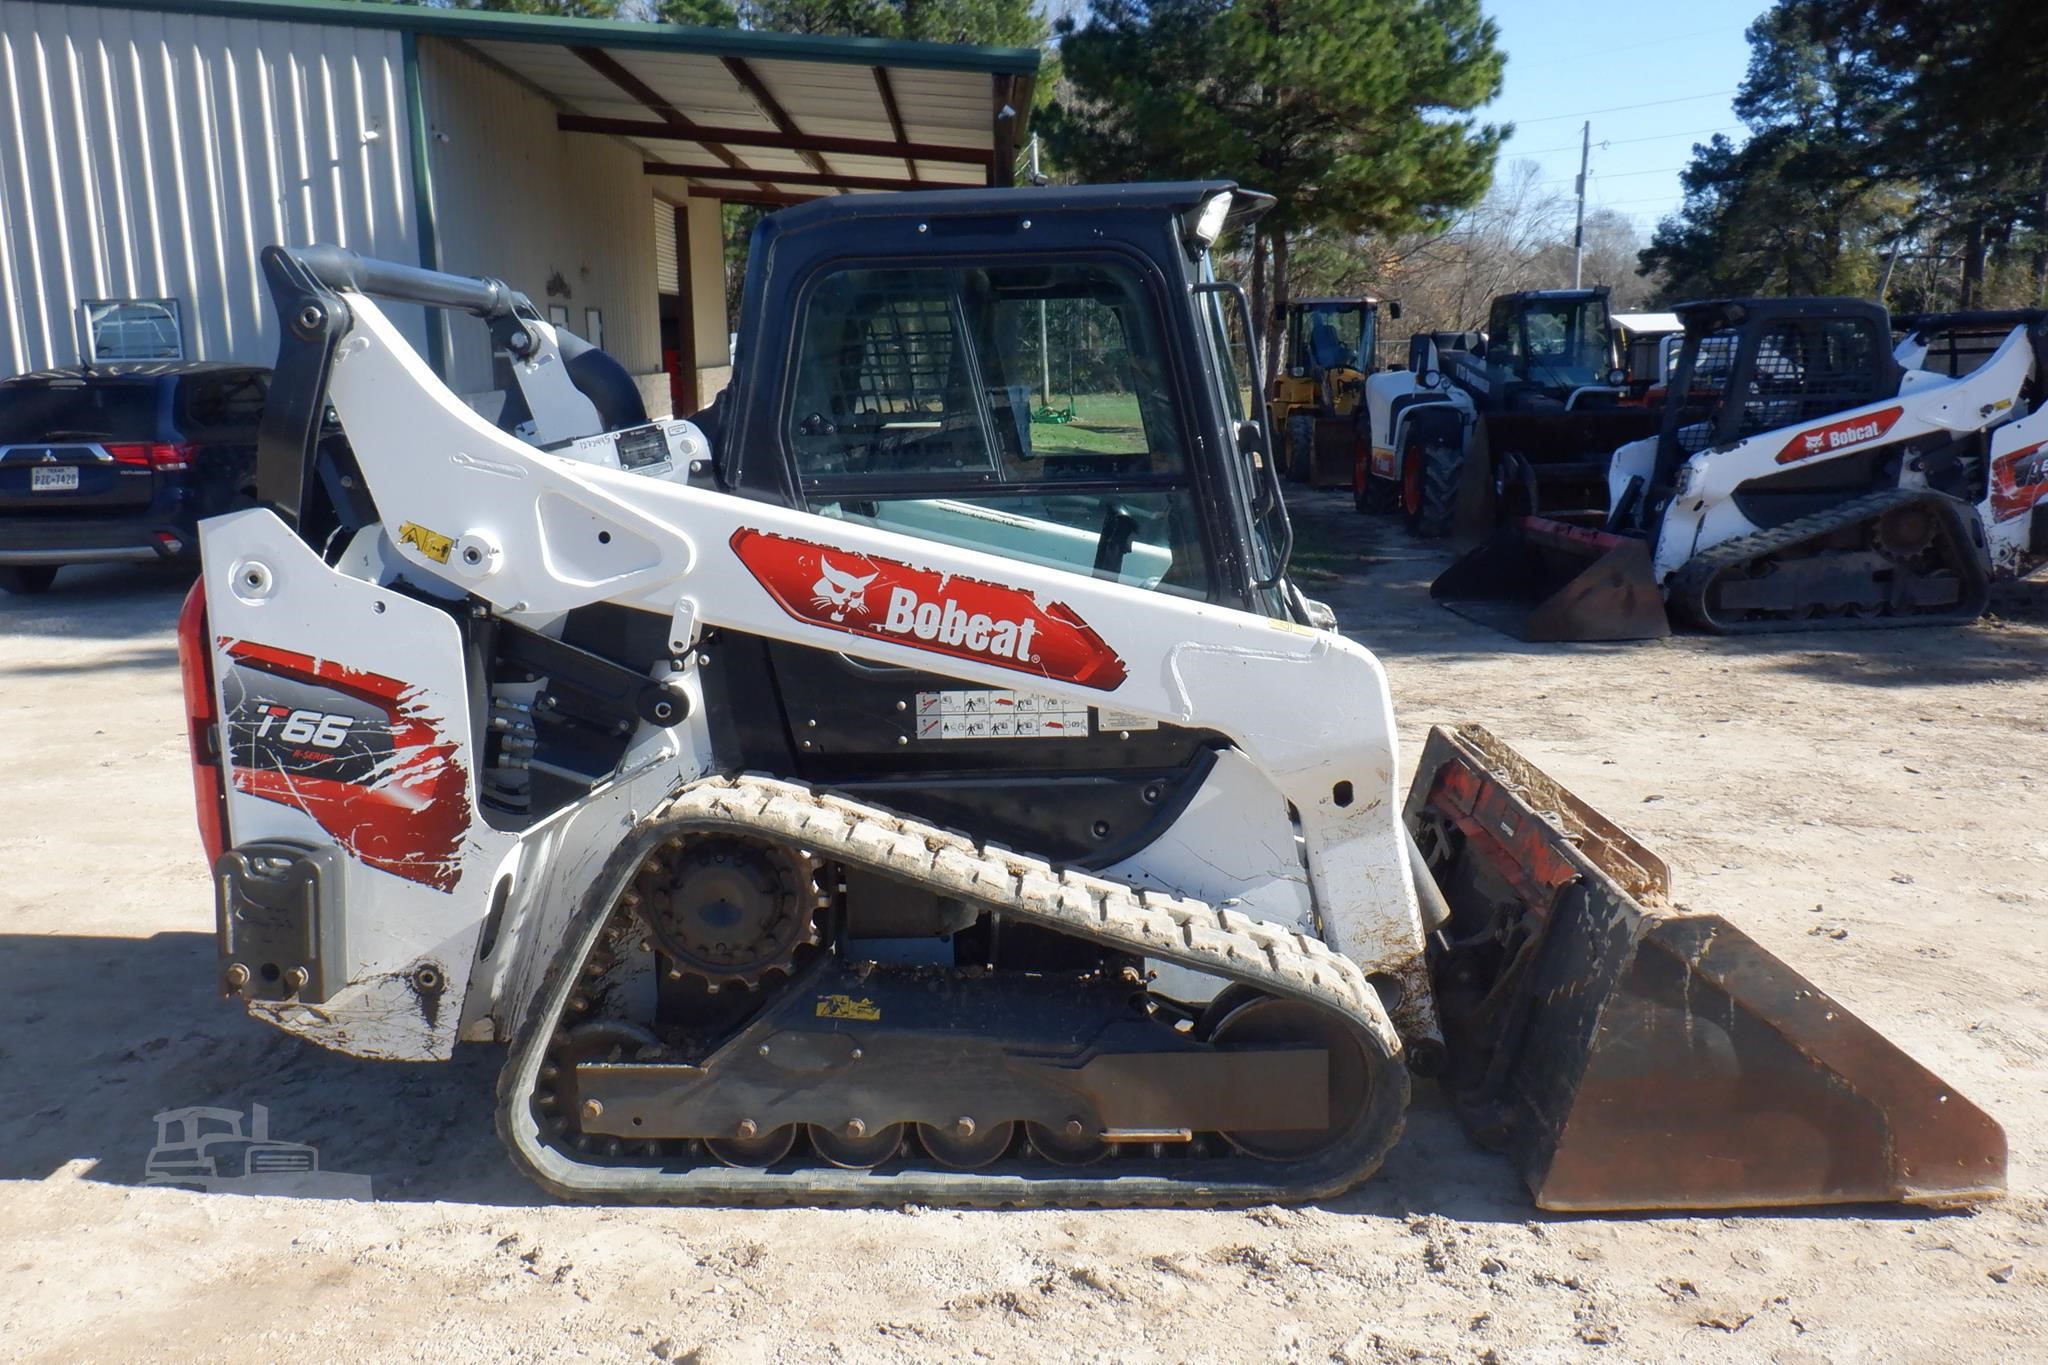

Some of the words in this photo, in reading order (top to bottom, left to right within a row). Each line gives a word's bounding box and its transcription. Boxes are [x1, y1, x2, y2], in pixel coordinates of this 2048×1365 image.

[1829, 421, 1879, 448] Bobcat
[885, 586, 1036, 662] Bobcat
[257, 704, 354, 748] T66
